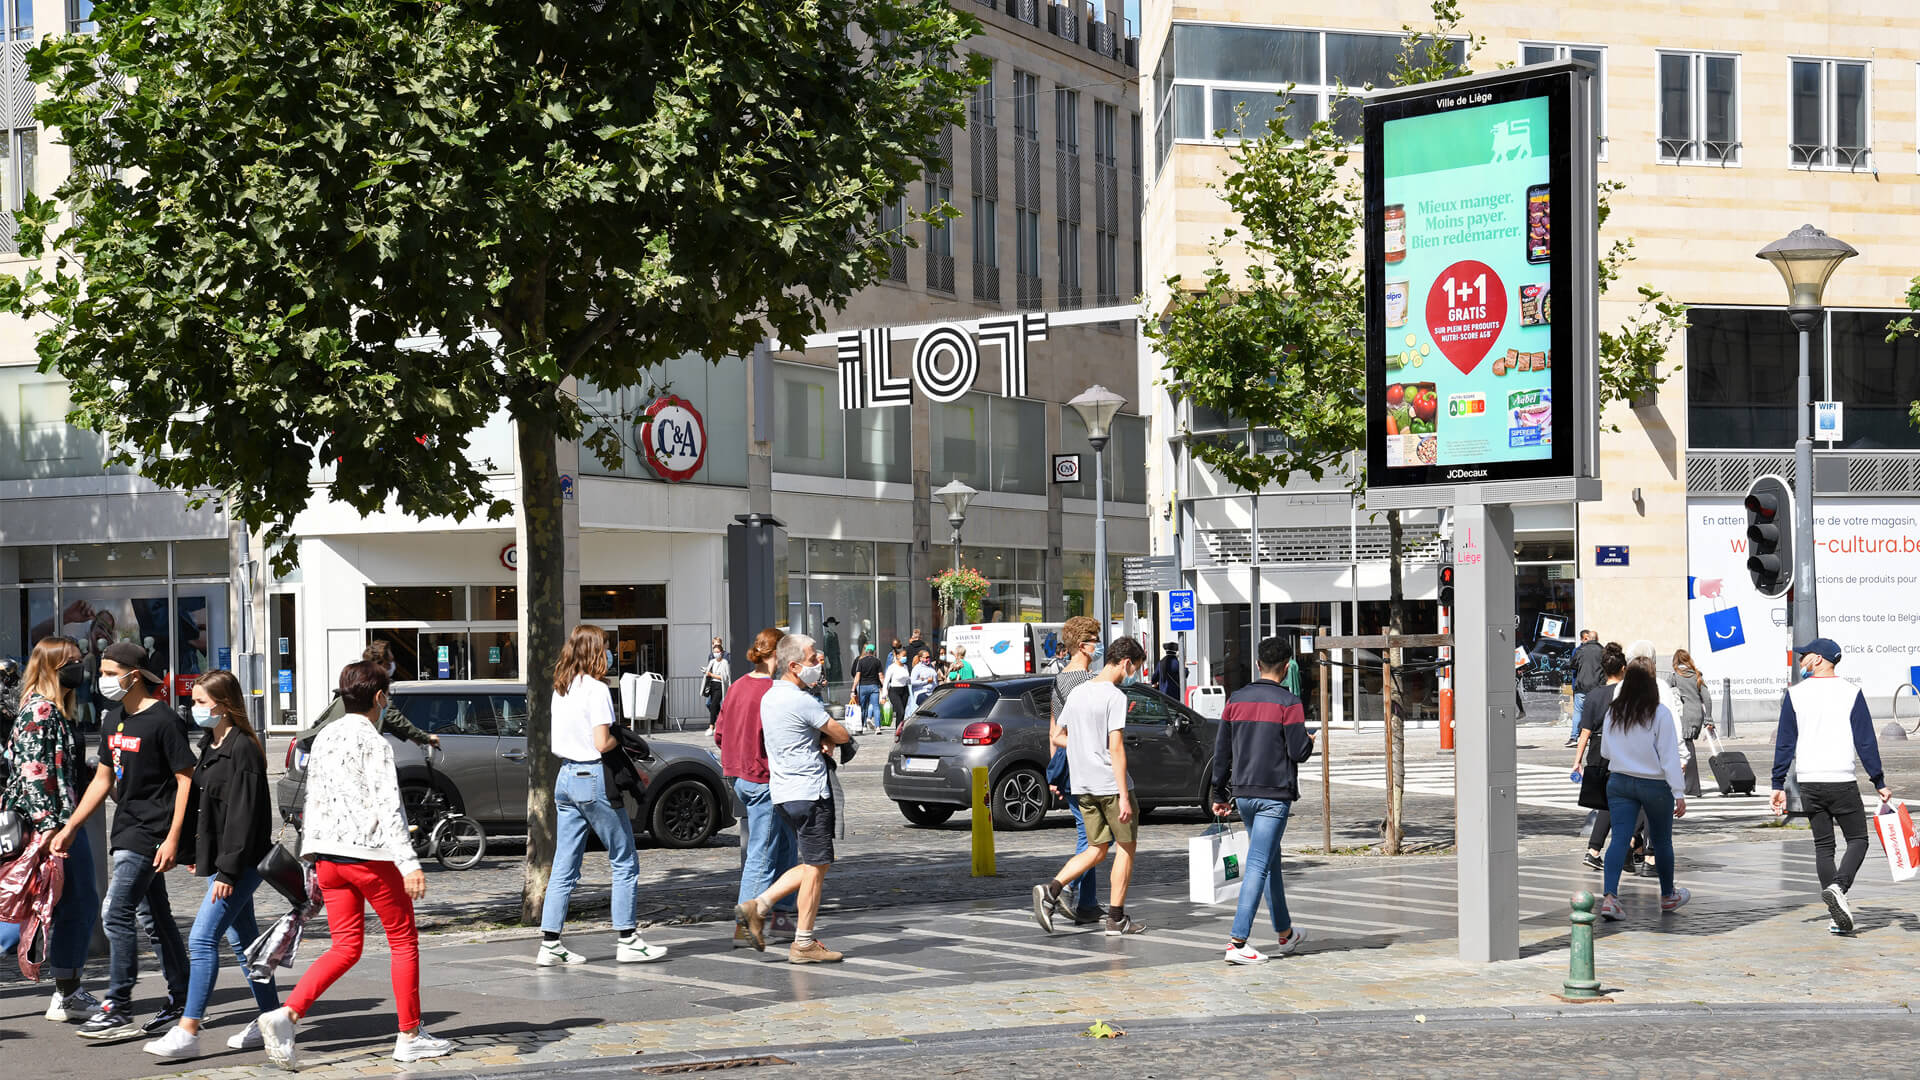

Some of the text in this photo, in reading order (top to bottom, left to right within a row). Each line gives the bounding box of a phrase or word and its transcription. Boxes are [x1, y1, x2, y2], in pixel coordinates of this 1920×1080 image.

[1436, 92, 1493, 109] Ville de Liège
[1418, 192, 1514, 216] Mieux manger.
[1426, 211, 1507, 231] Moins payer.
[1411, 225, 1521, 249] Bien redémarrer.
[1442, 274, 1487, 308] 1+1
[1448, 306, 1487, 322] GRATIS
[1434, 321, 1500, 335] SUR PLEIN DE PRODUITS
[1441, 331, 1479, 342] NUTRI-SCORE
[1818, 402, 1837, 410] WIFI
[658, 418, 698, 458] C&A
[1446, 469, 1488, 479] JCDecaux
[1702, 515, 1715, 526] En
[1717, 516, 1745, 526] atten
[1828, 515, 1841, 526] de
[1843, 516, 1869, 526] votre
[1872, 516, 1918, 529] magasin,
[1457, 551, 1481, 565] Liège
[1816, 575, 1917, 586] ctions de produits pour
[1818, 614, 1837, 622] ison
[1839, 613, 1861, 623] dans
[1862, 614, 1886, 622] toute
[1888, 613, 1896, 622] la
[1843, 645, 1864, 653] Click
[1866, 645, 1874, 653] &
[1876, 645, 1904, 653] Collect
